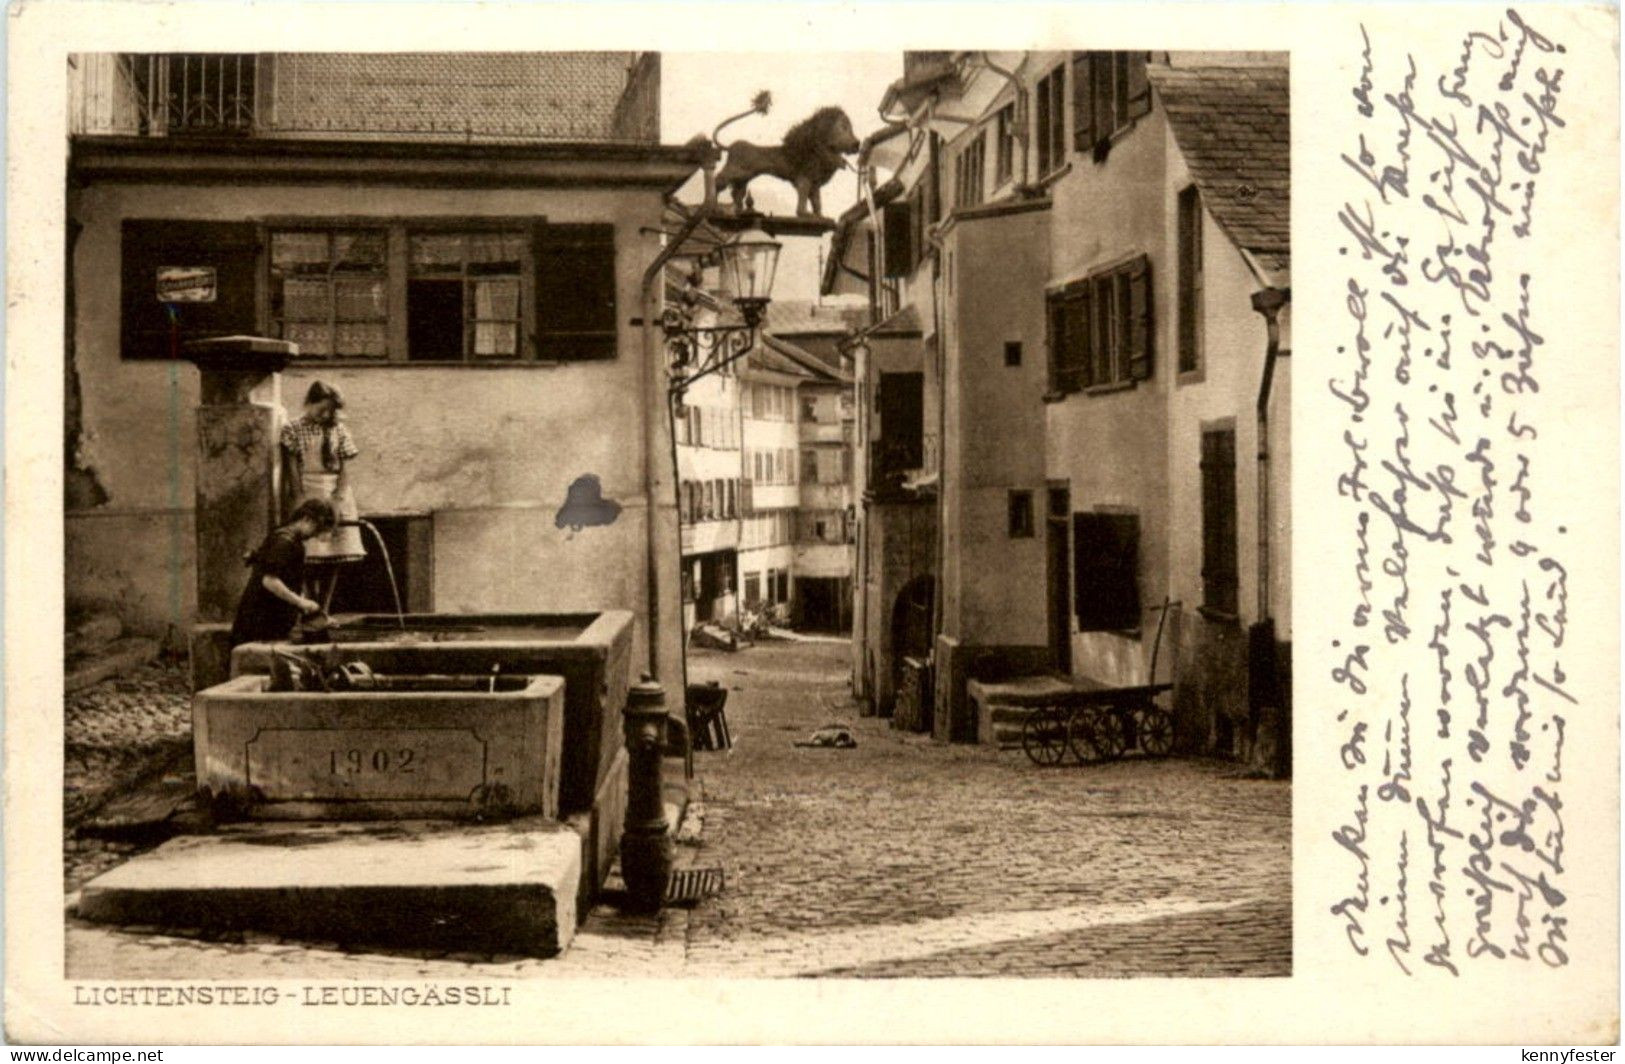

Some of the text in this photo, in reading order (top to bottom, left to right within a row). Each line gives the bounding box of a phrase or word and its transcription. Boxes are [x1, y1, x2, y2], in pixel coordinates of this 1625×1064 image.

[1353, 21, 1373, 117] von
[1341, 132, 1383, 193] so
[1338, 198, 1393, 259] ist
[1382, 230, 1410, 285] die
[1381, 290, 1431, 384] auf
[1507, 409, 1537, 439] 5
[1368, 401, 1431, 643] Velofahrer
[329, 749, 416, 775] 1902
[1416, 757, 1464, 975] geworfen
